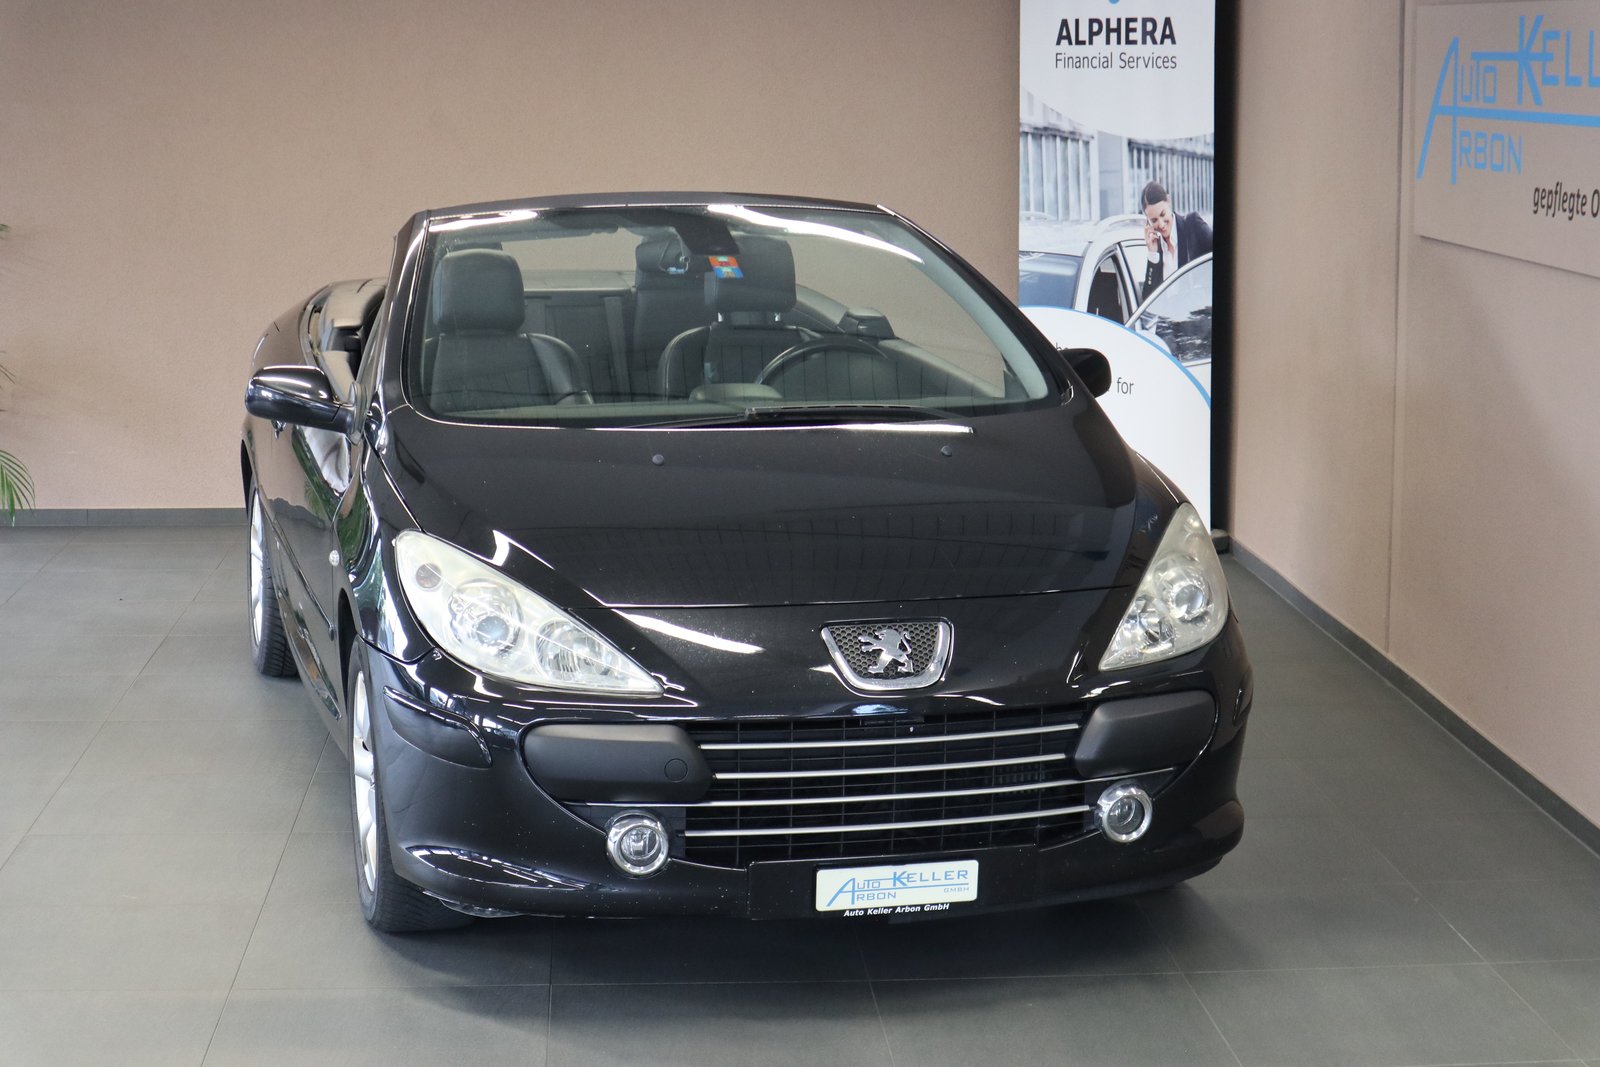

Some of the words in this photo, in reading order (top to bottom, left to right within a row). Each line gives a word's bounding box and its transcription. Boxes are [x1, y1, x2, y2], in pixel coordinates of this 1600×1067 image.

[1055, 16, 1177, 46] ALPHERA
[1055, 52, 1113, 69] Financial
[1119, 52, 1177, 69] Services
[1533, 181, 1588, 221] gepflegte
[1116, 376, 1135, 395] for
[892, 869, 969, 888] KELLER
[843, 909, 865, 917] Auto
[867, 907, 893, 915] Keller
[895, 905, 921, 914] Arbon
[924, 903, 950, 912] GmbH
